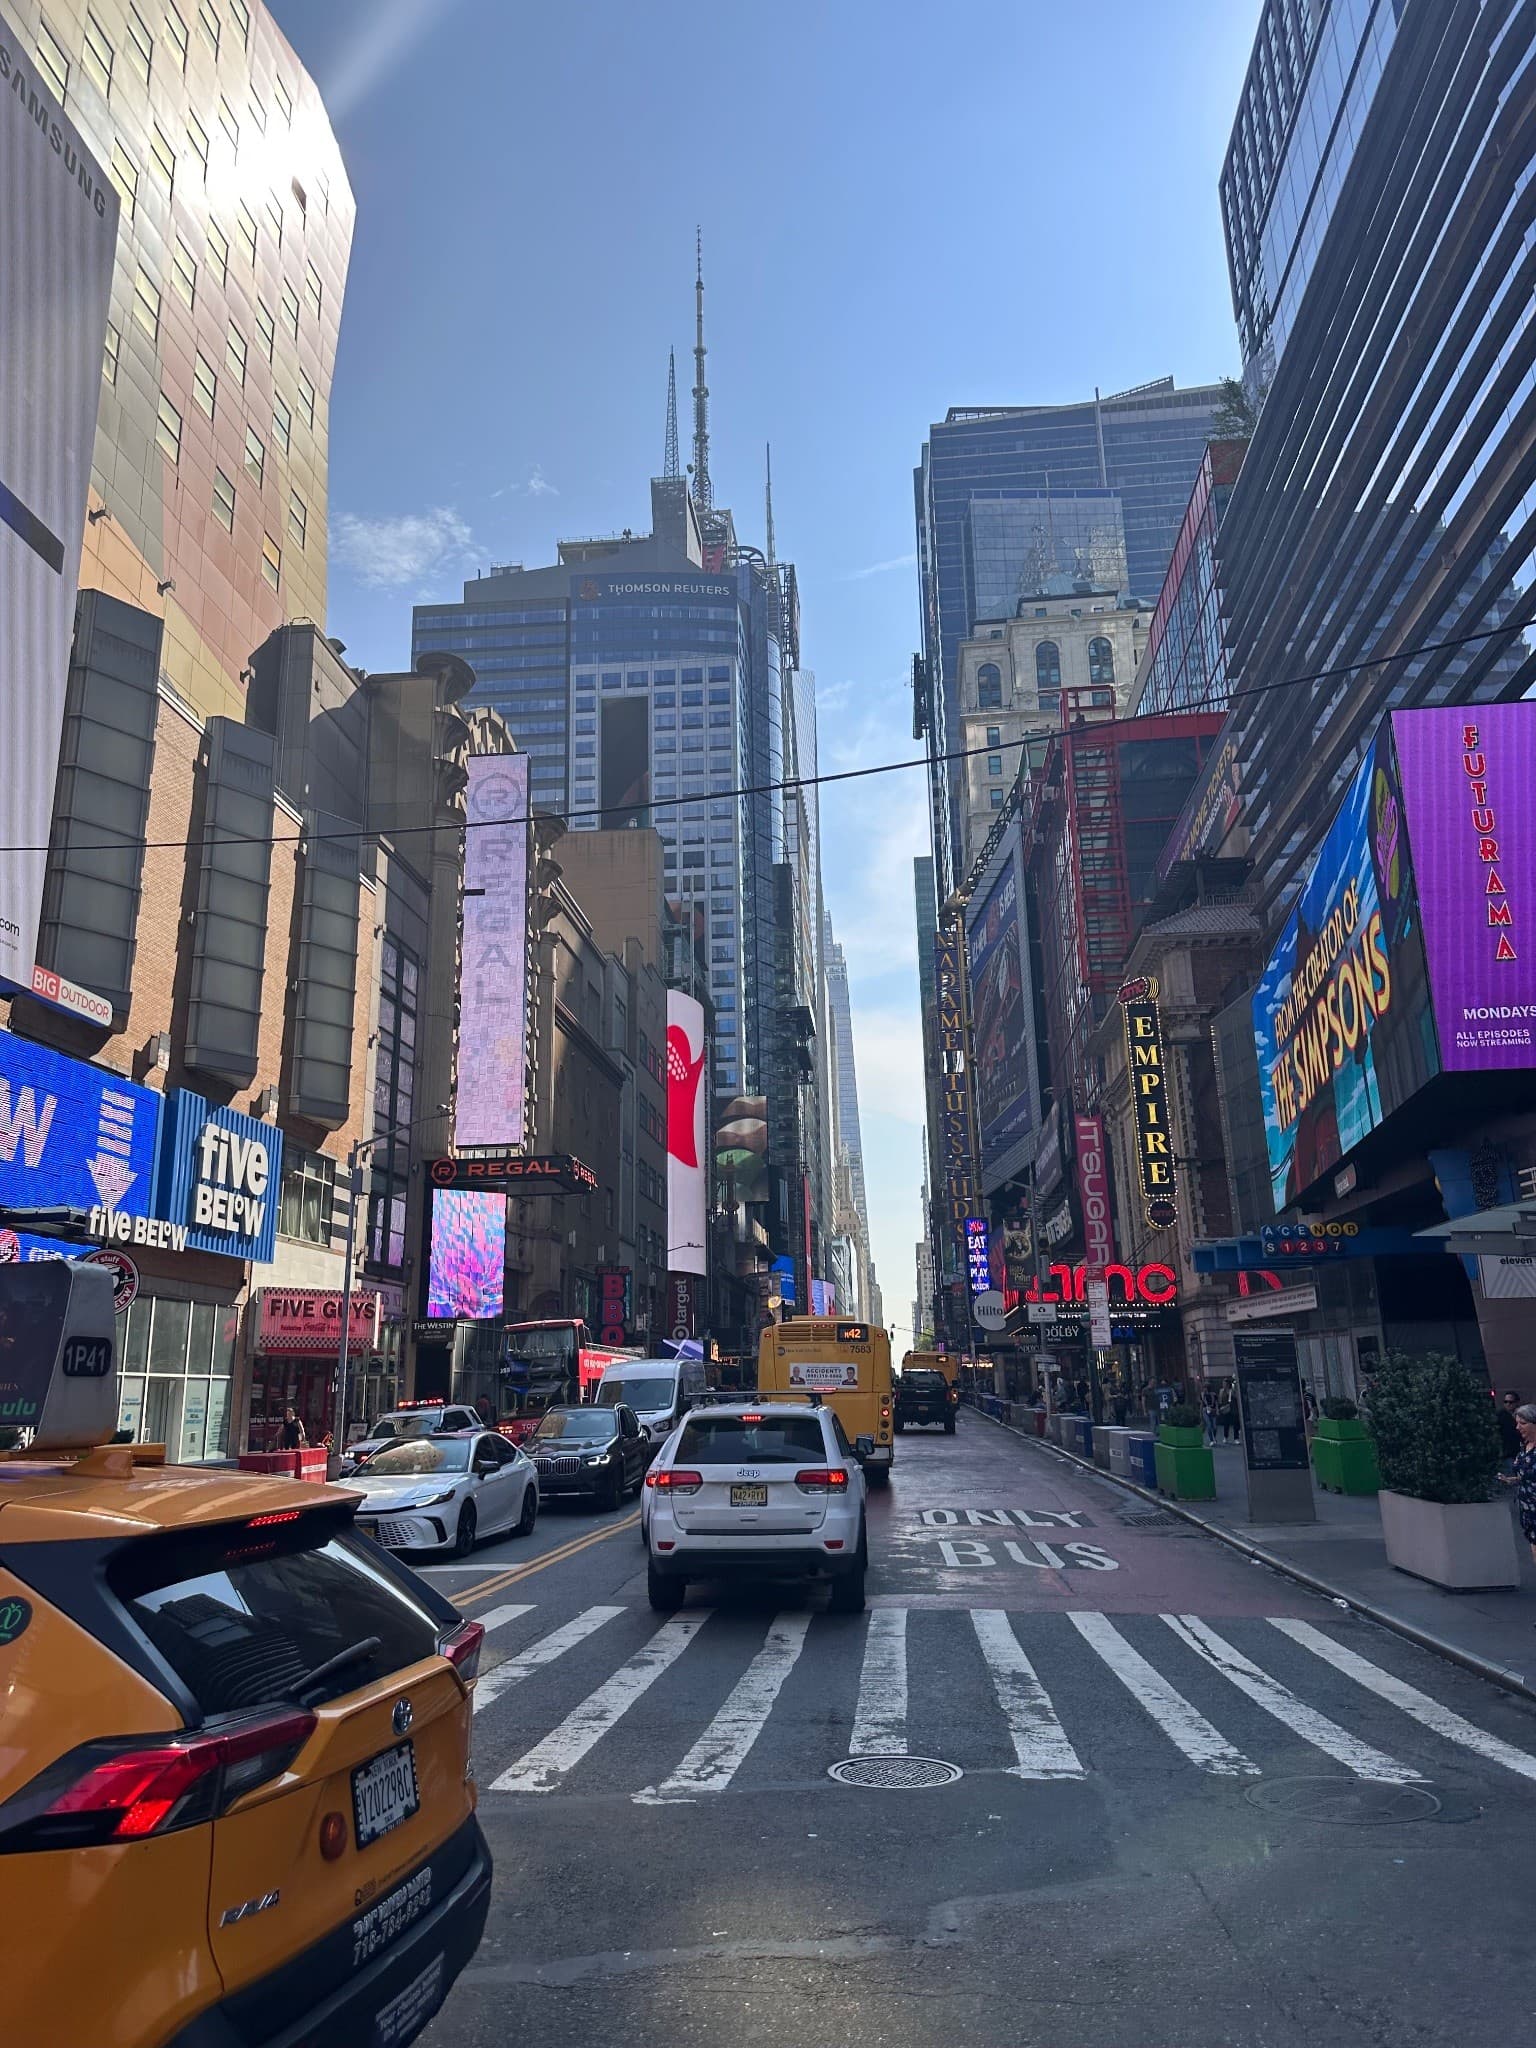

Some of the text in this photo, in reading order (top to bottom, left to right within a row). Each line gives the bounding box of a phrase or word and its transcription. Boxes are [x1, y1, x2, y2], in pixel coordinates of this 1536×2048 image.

[0, 44, 106, 218] SAMSUNG
[607, 583, 730, 596] THOMSON REUTERS
[1462, 725, 1517, 960] FUTURAMA
[475, 839, 514, 1006] REGAL
[1274, 877, 1359, 1050] FROM THE CREATOR OF
[33, 968, 110, 1021] BIG OUTDOOR
[936, 932, 962, 1050] MADAME
[1271, 911, 1392, 1134] THE SIMPSONS
[1463, 1005, 1536, 1020] MONDAYS
[1456, 1028, 1530, 1041] ALL EPISODES
[1456, 1037, 1531, 1048] NOW STREAMING
[1133, 1016, 1170, 1185] EMPIRE
[200, 1122, 268, 1196] five
[467, 1160, 561, 1177] REGAL
[1078, 1120, 1110, 1266] IT'SUGAR
[90, 1206, 190, 1252] five BELOW
[195, 1185, 265, 1238] BELOW
[967, 1236, 986, 1249] EAT
[1500, 1256, 1533, 1265] eleven
[1025, 1263, 1177, 1303] amc
[270, 1298, 376, 1320] FIVE GYS
[601, 1274, 625, 1346] BBQ
[674, 1279, 690, 1325] target
[977, 1306, 1003, 1317] Hilto
[413, 1321, 455, 1330] THE WESTIN
[66, 1344, 106, 1372] 1P41
[806, 1367, 842, 1375] ACCIDENT?
[0, 1397, 36, 1416] ulu
[737, 1468, 760, 1478] Jeep
[921, 1509, 1083, 1528] ONLY
[937, 1540, 1120, 1571] BUS
[361, 1763, 411, 1825] Y202298C
